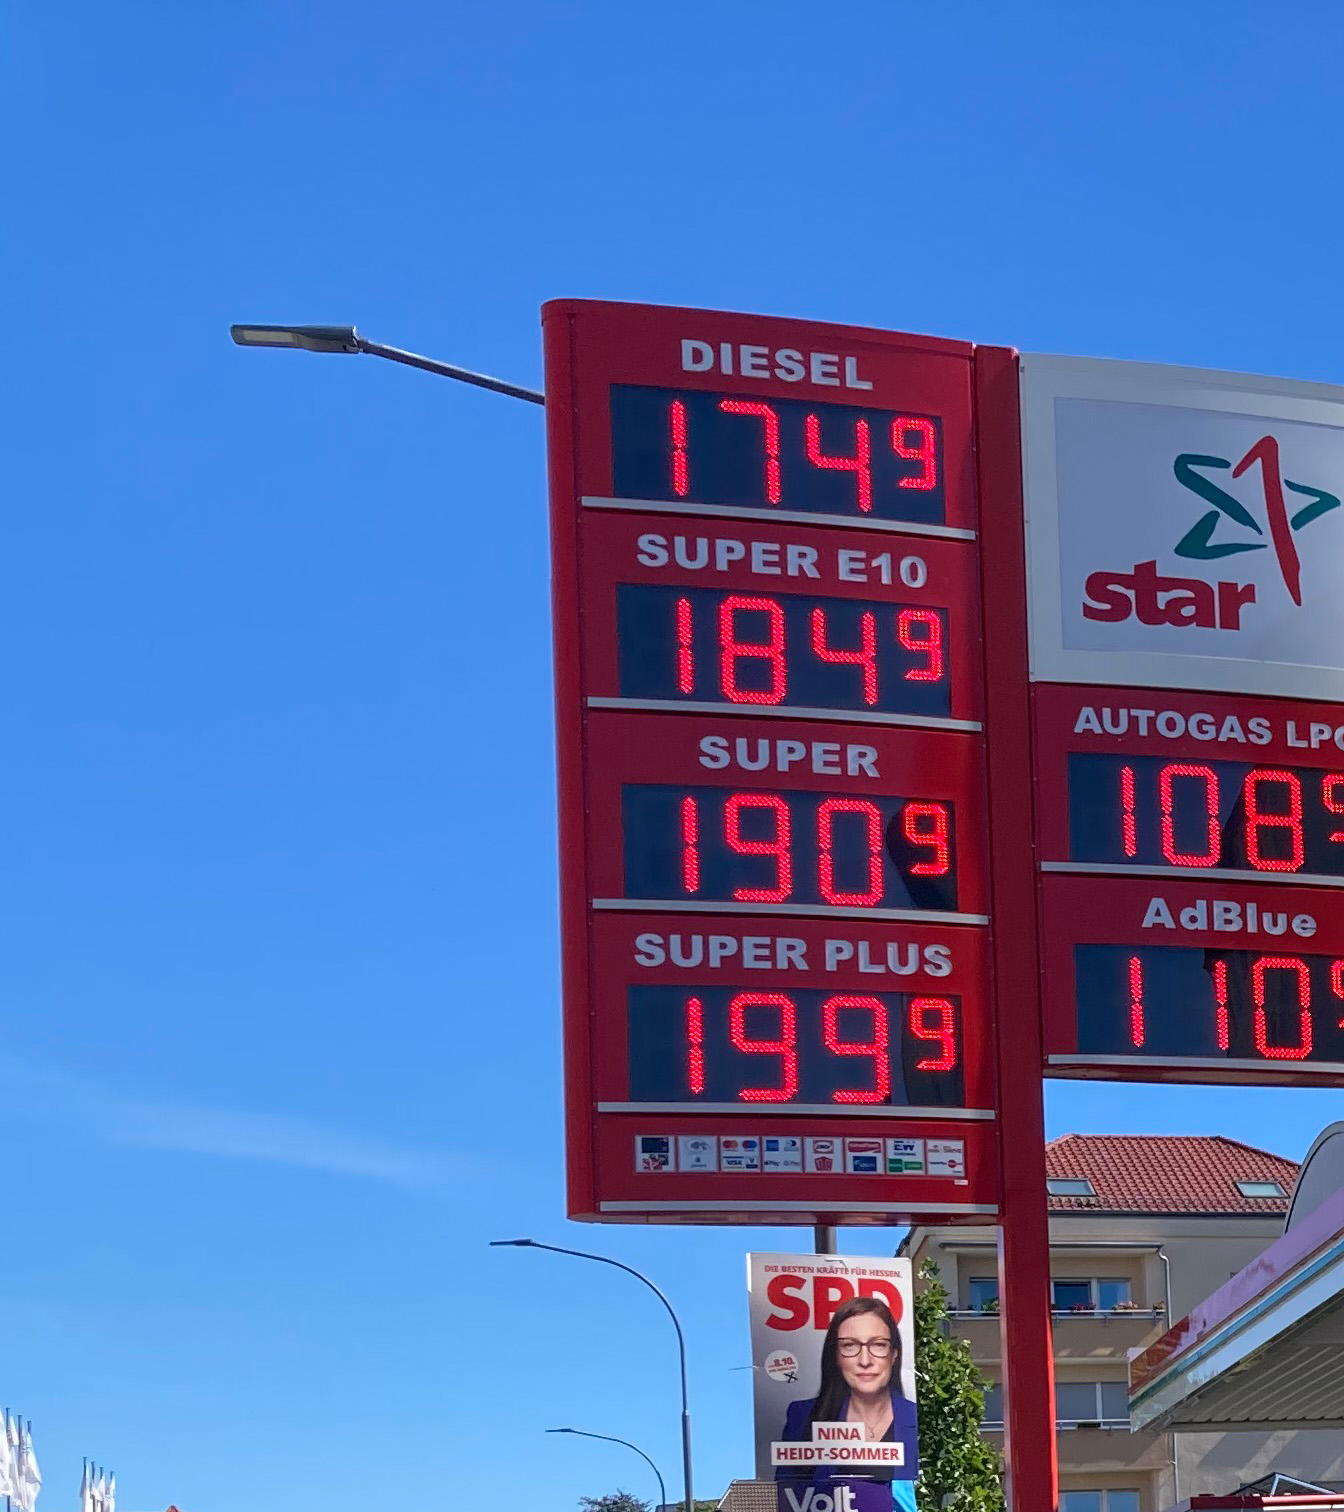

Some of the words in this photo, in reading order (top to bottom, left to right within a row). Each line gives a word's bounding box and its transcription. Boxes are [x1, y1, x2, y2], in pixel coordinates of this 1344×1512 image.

[681, 338, 873, 391] DIESEL
[636, 533, 821, 579] SUPER
[837, 549, 928, 589] E10
[1082, 559, 1257, 631] star
[1074, 706, 1273, 746] AUTOGAS
[698, 735, 881, 780] SUPER
[1142, 897, 1318, 938] AdBlue
[633, 933, 810, 971] SUPER
[824, 938, 954, 977] PLUS
[782, 1265, 815, 1273] BESTEN
[816, 1265, 849, 1275] KRÄFTE
[851, 1267, 867, 1276] FÜR
[776, 1447, 900, 1461] HEIDT-SOMMER
[817, 1427, 861, 1441] NINA
